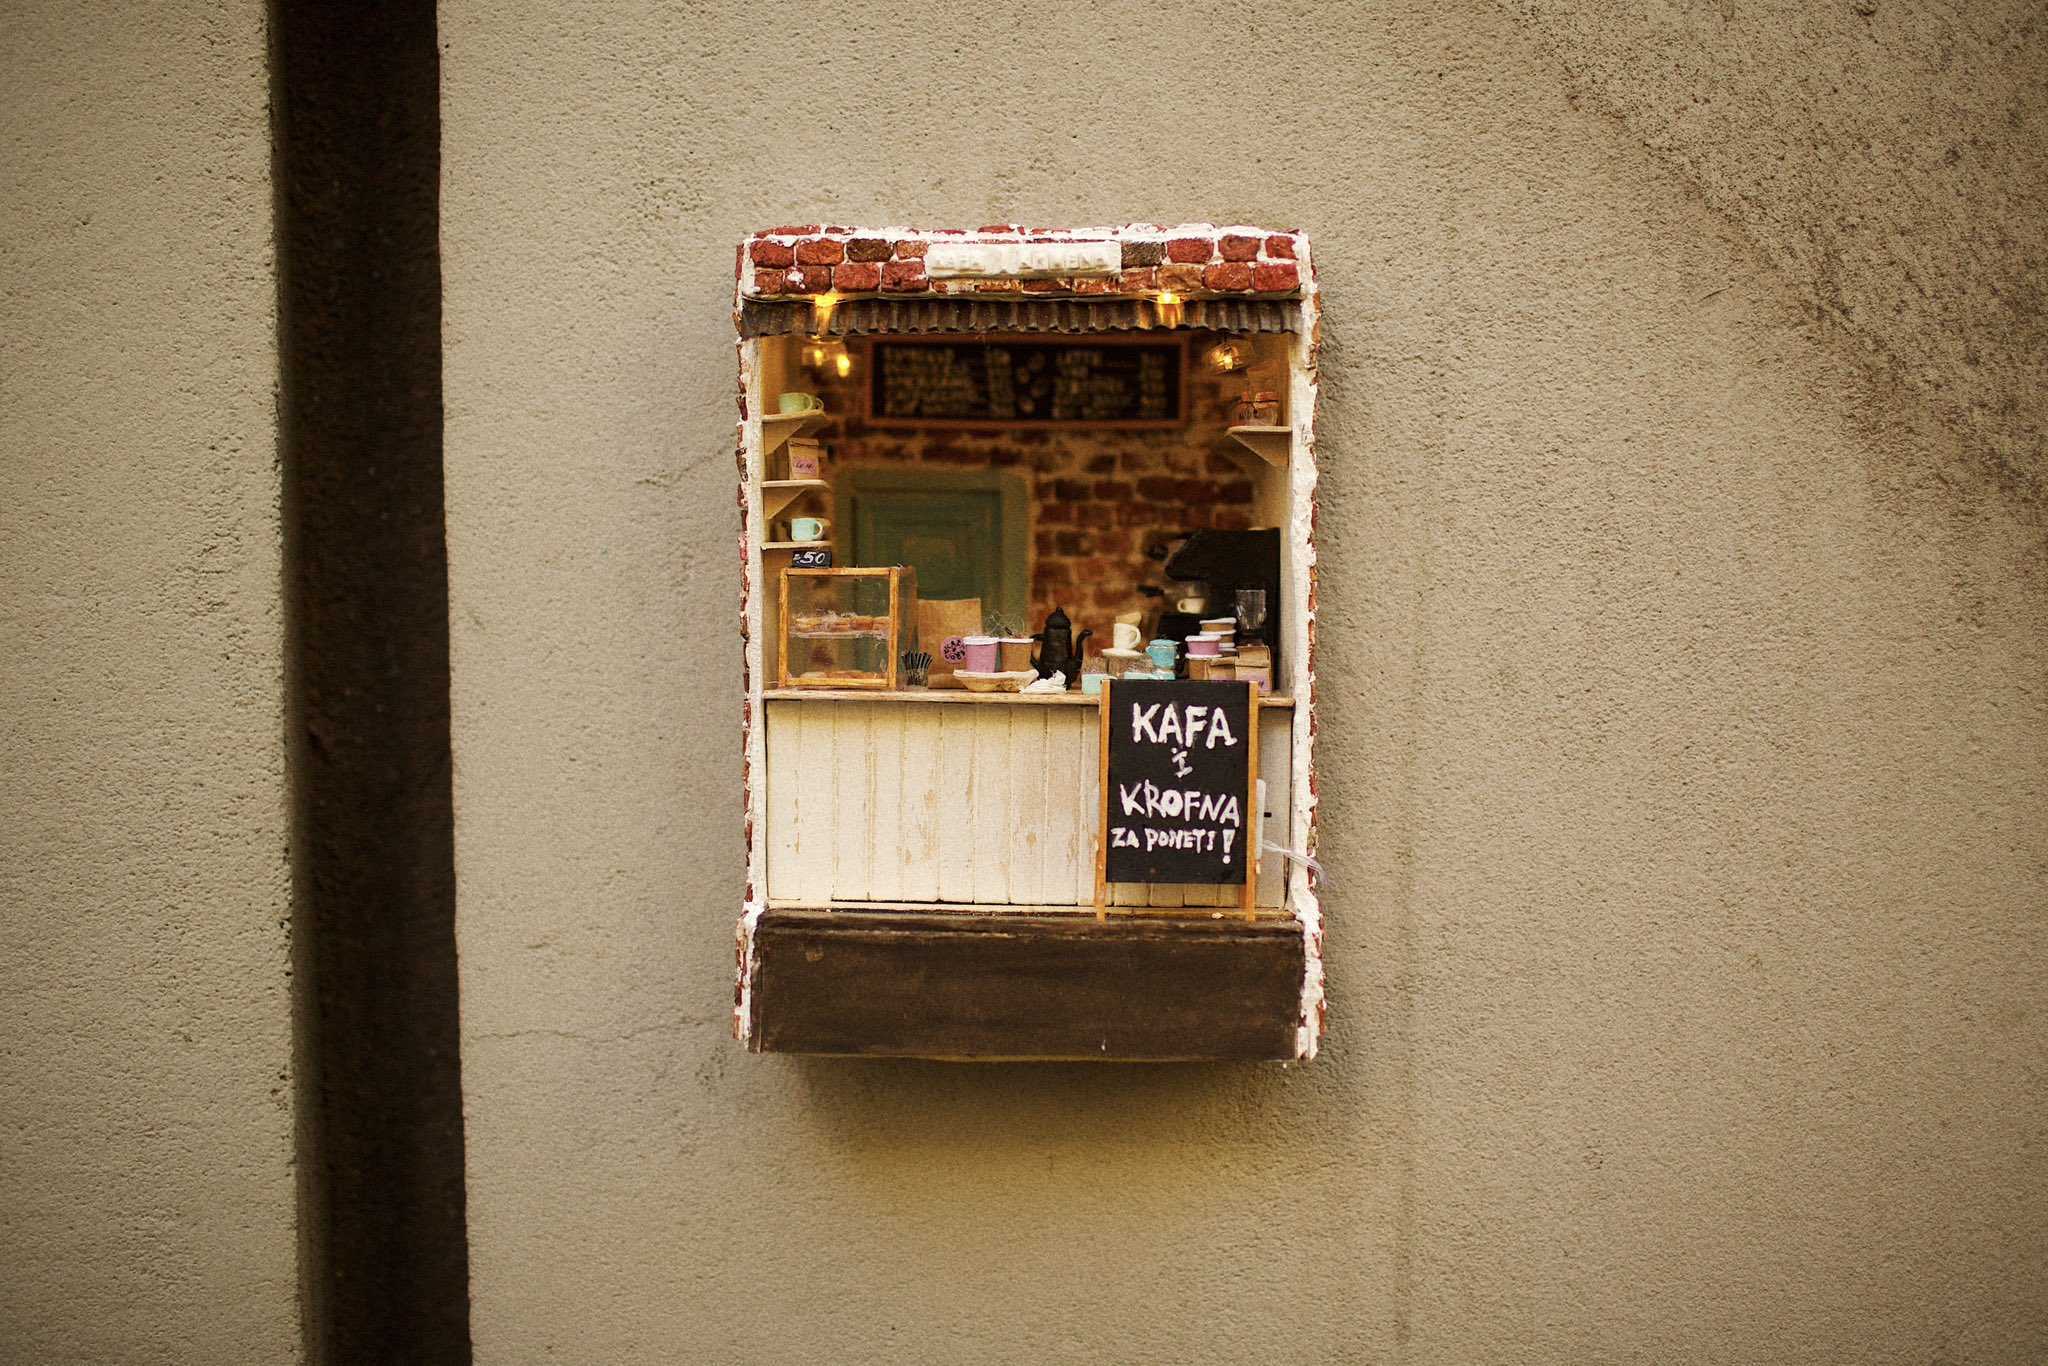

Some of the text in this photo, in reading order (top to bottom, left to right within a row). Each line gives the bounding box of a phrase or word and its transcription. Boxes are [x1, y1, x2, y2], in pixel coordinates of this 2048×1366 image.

[1131, 702, 1238, 749] KAFA
[1119, 779, 1240, 828] KROFNA
[1110, 827, 1140, 848] ZA
